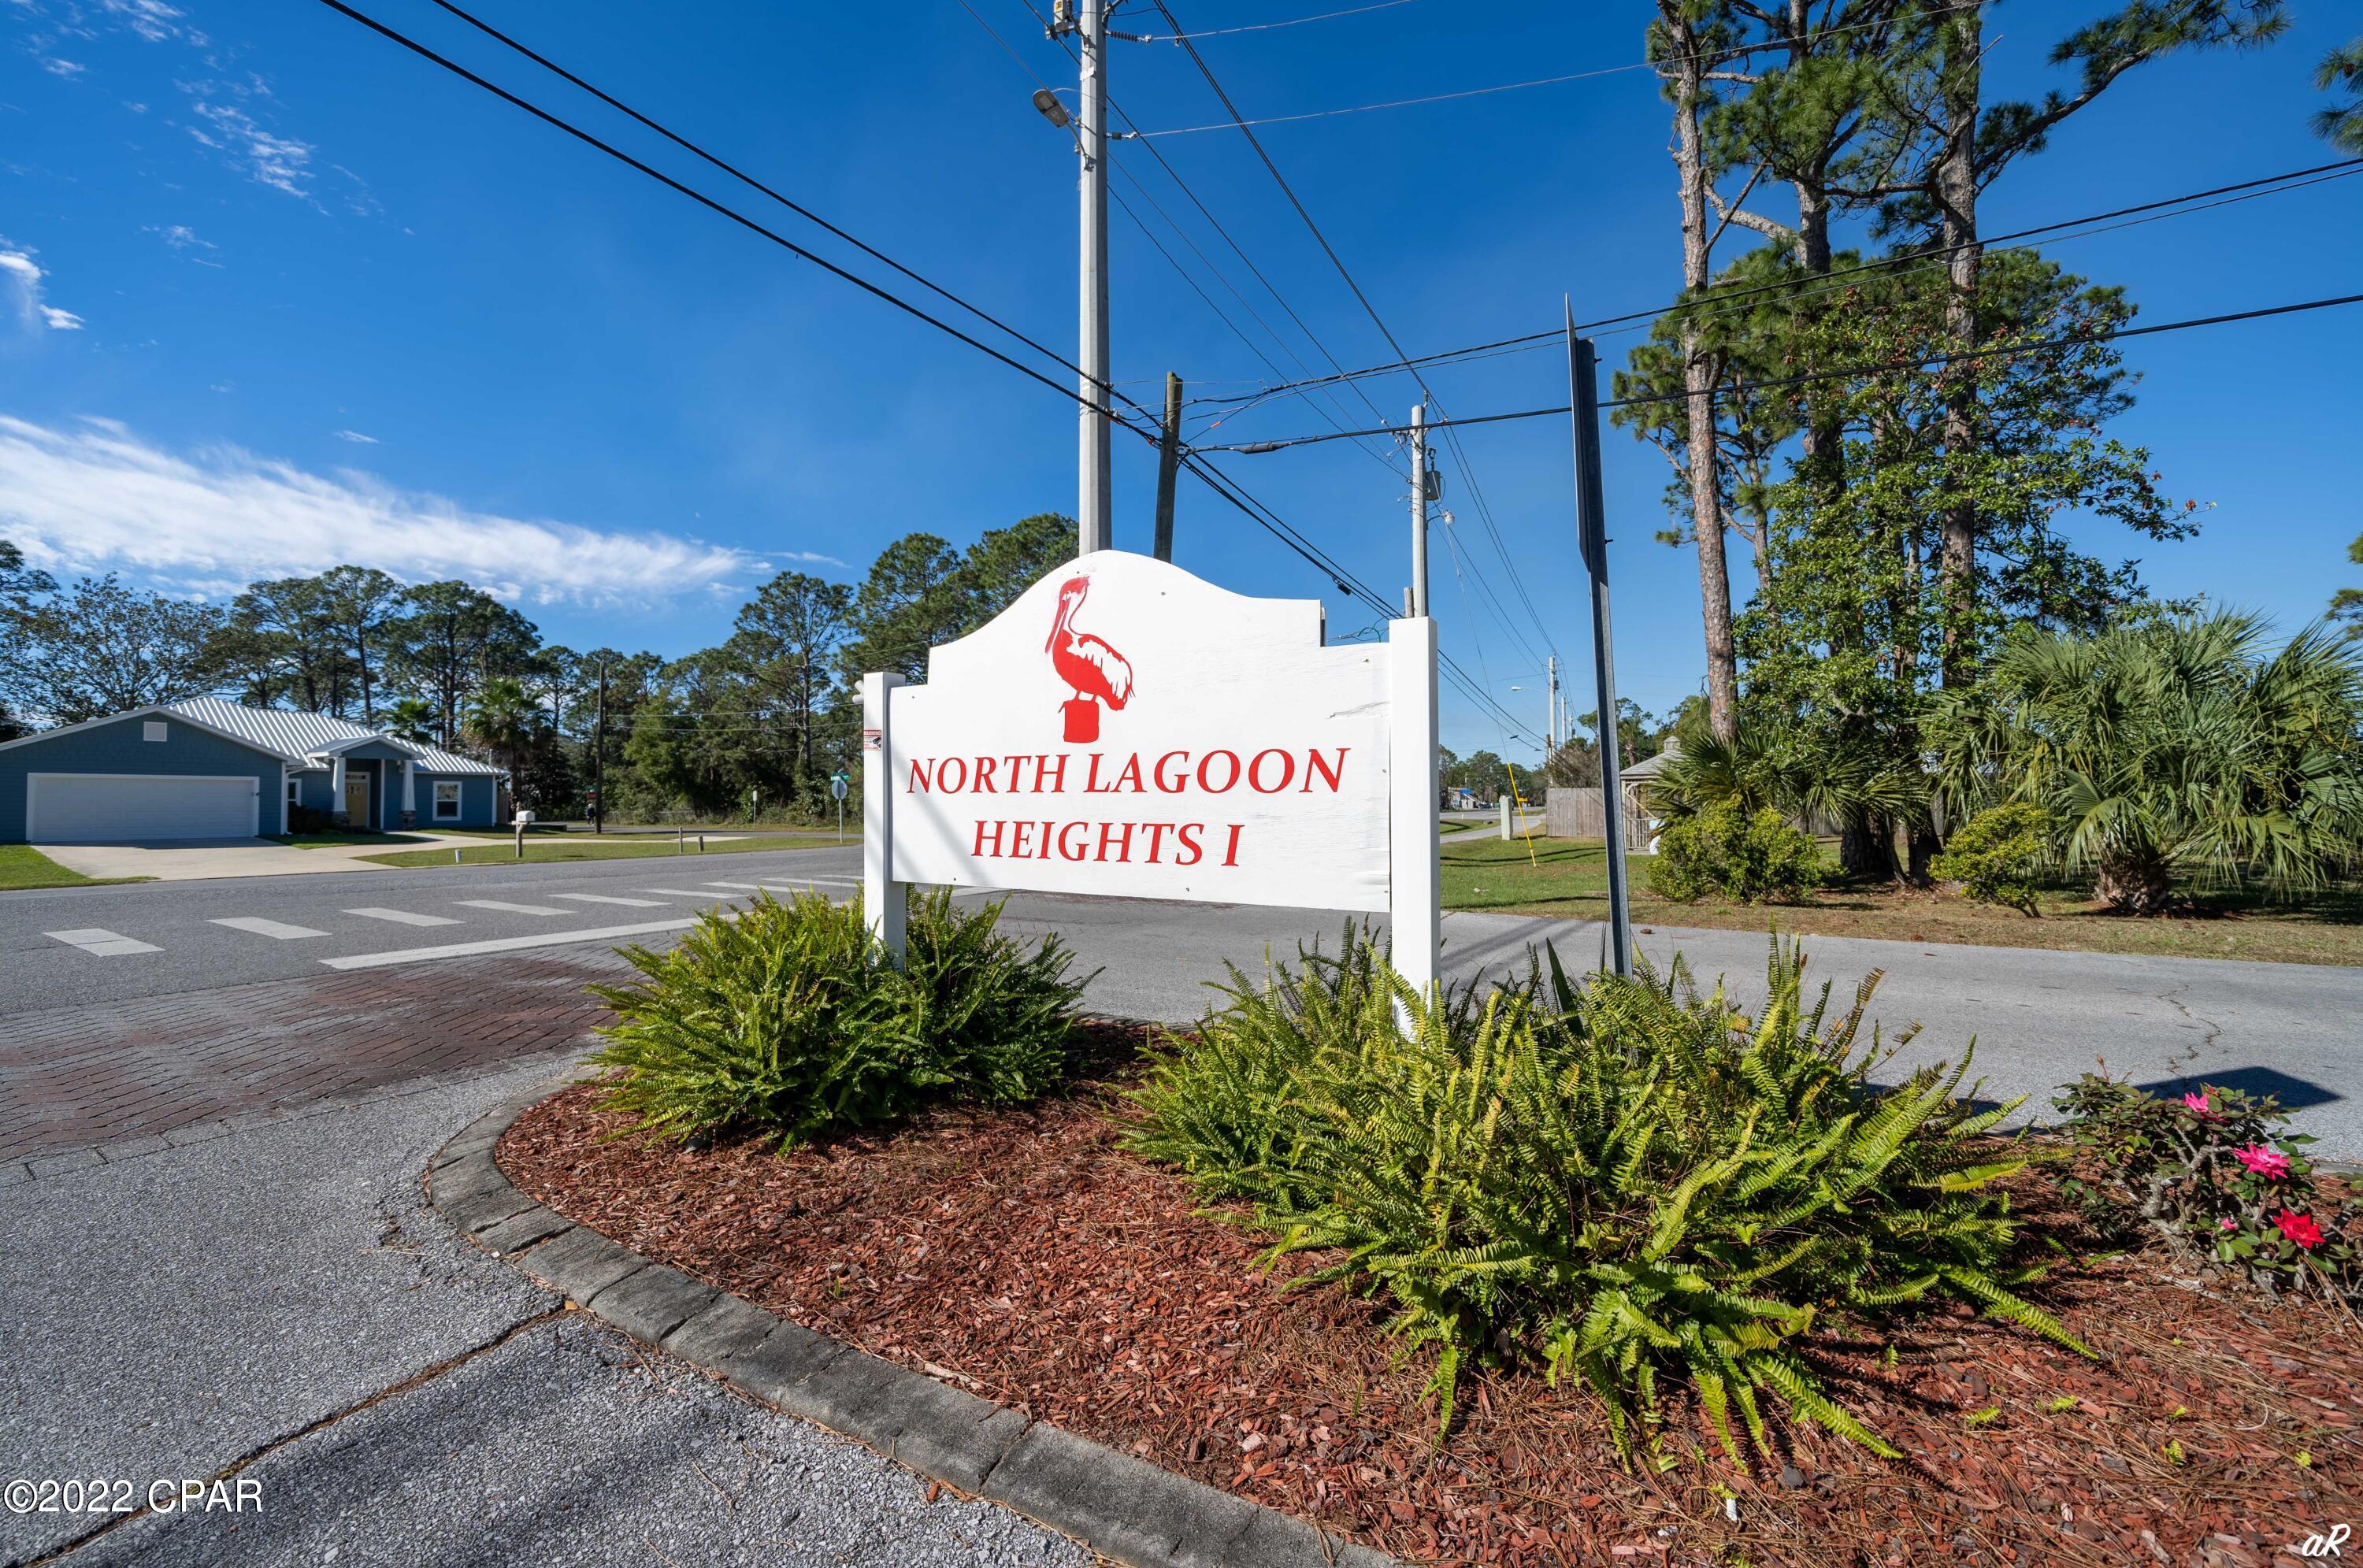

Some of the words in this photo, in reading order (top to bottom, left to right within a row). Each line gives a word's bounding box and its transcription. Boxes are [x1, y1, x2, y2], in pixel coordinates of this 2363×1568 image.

[907, 754, 1070, 794] NORTH
[1082, 748, 1350, 795] LAGOON
[971, 820, 1205, 866] HEIGHTS
[1221, 824, 1245, 867] I
